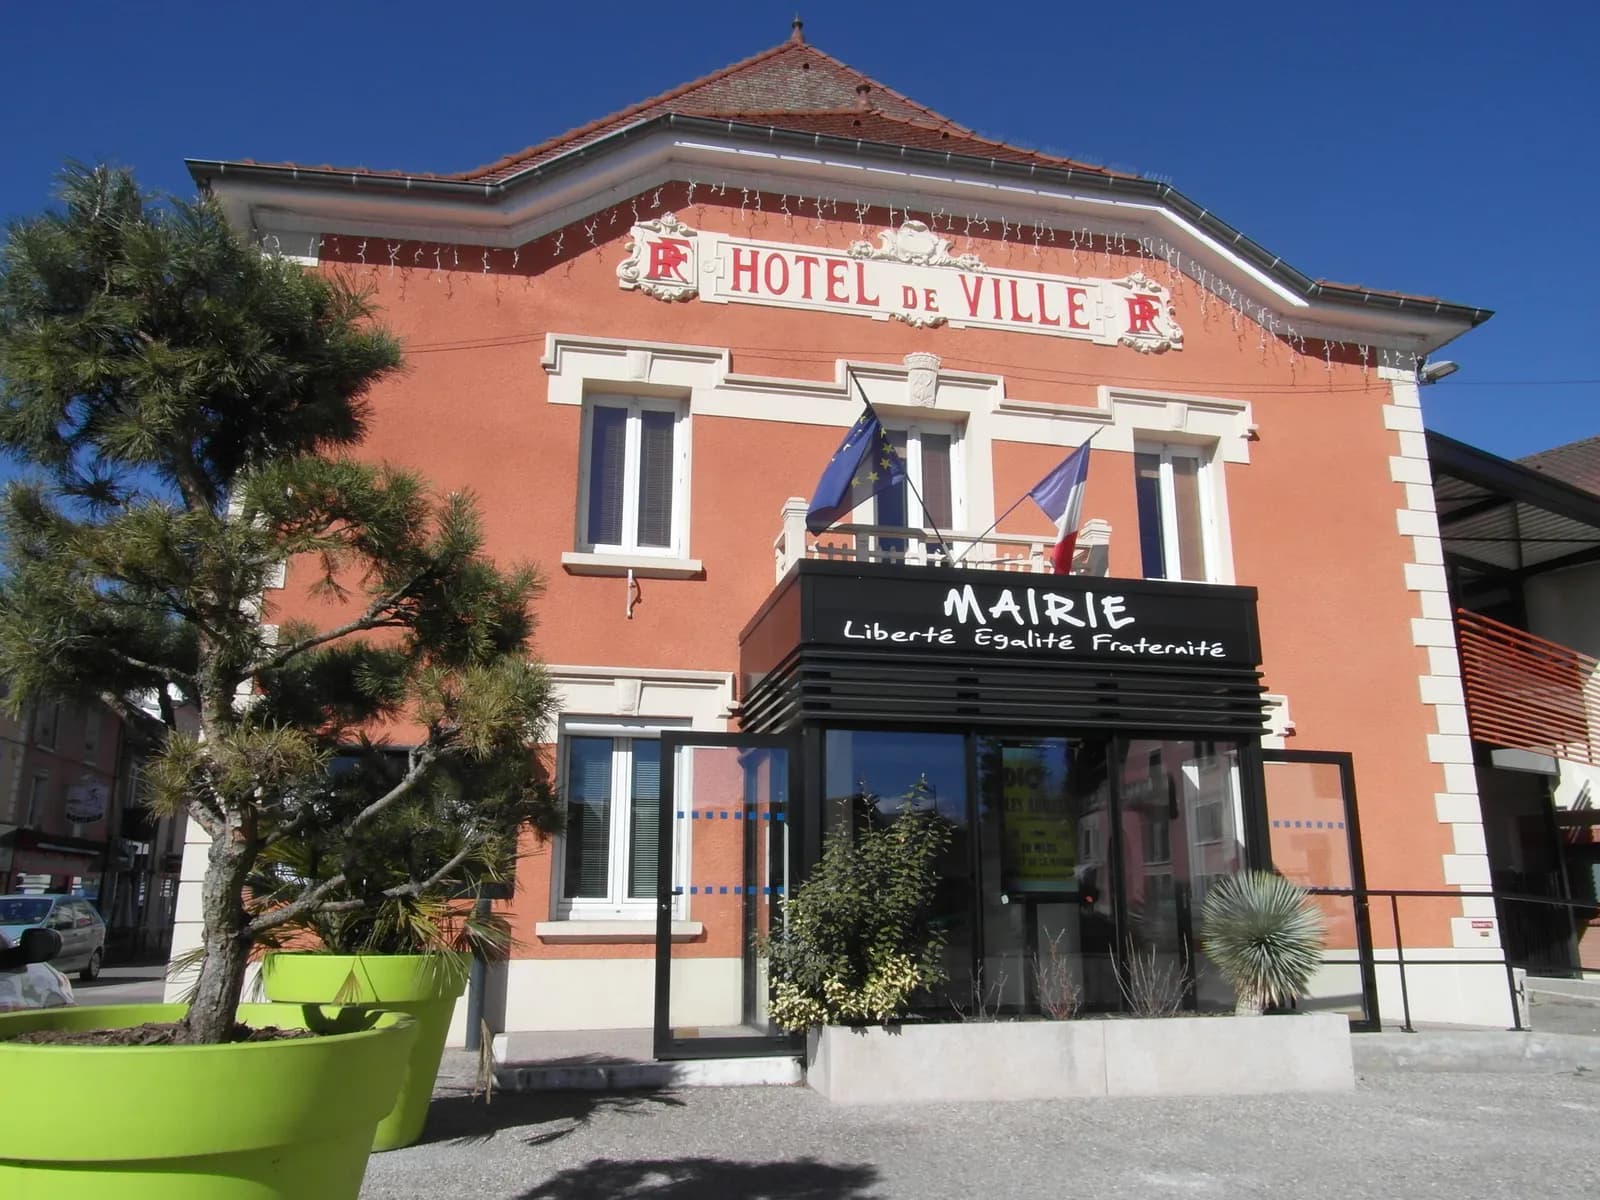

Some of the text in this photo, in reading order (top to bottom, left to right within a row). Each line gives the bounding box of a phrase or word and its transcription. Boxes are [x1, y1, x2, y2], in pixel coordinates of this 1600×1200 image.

[730, 247, 1090, 330] HOTEL DE VILLE
[943, 583, 1136, 630] MAIRIE
[843, 620, 957, 644] Liberté
[1092, 633, 1228, 658] Fraternité
